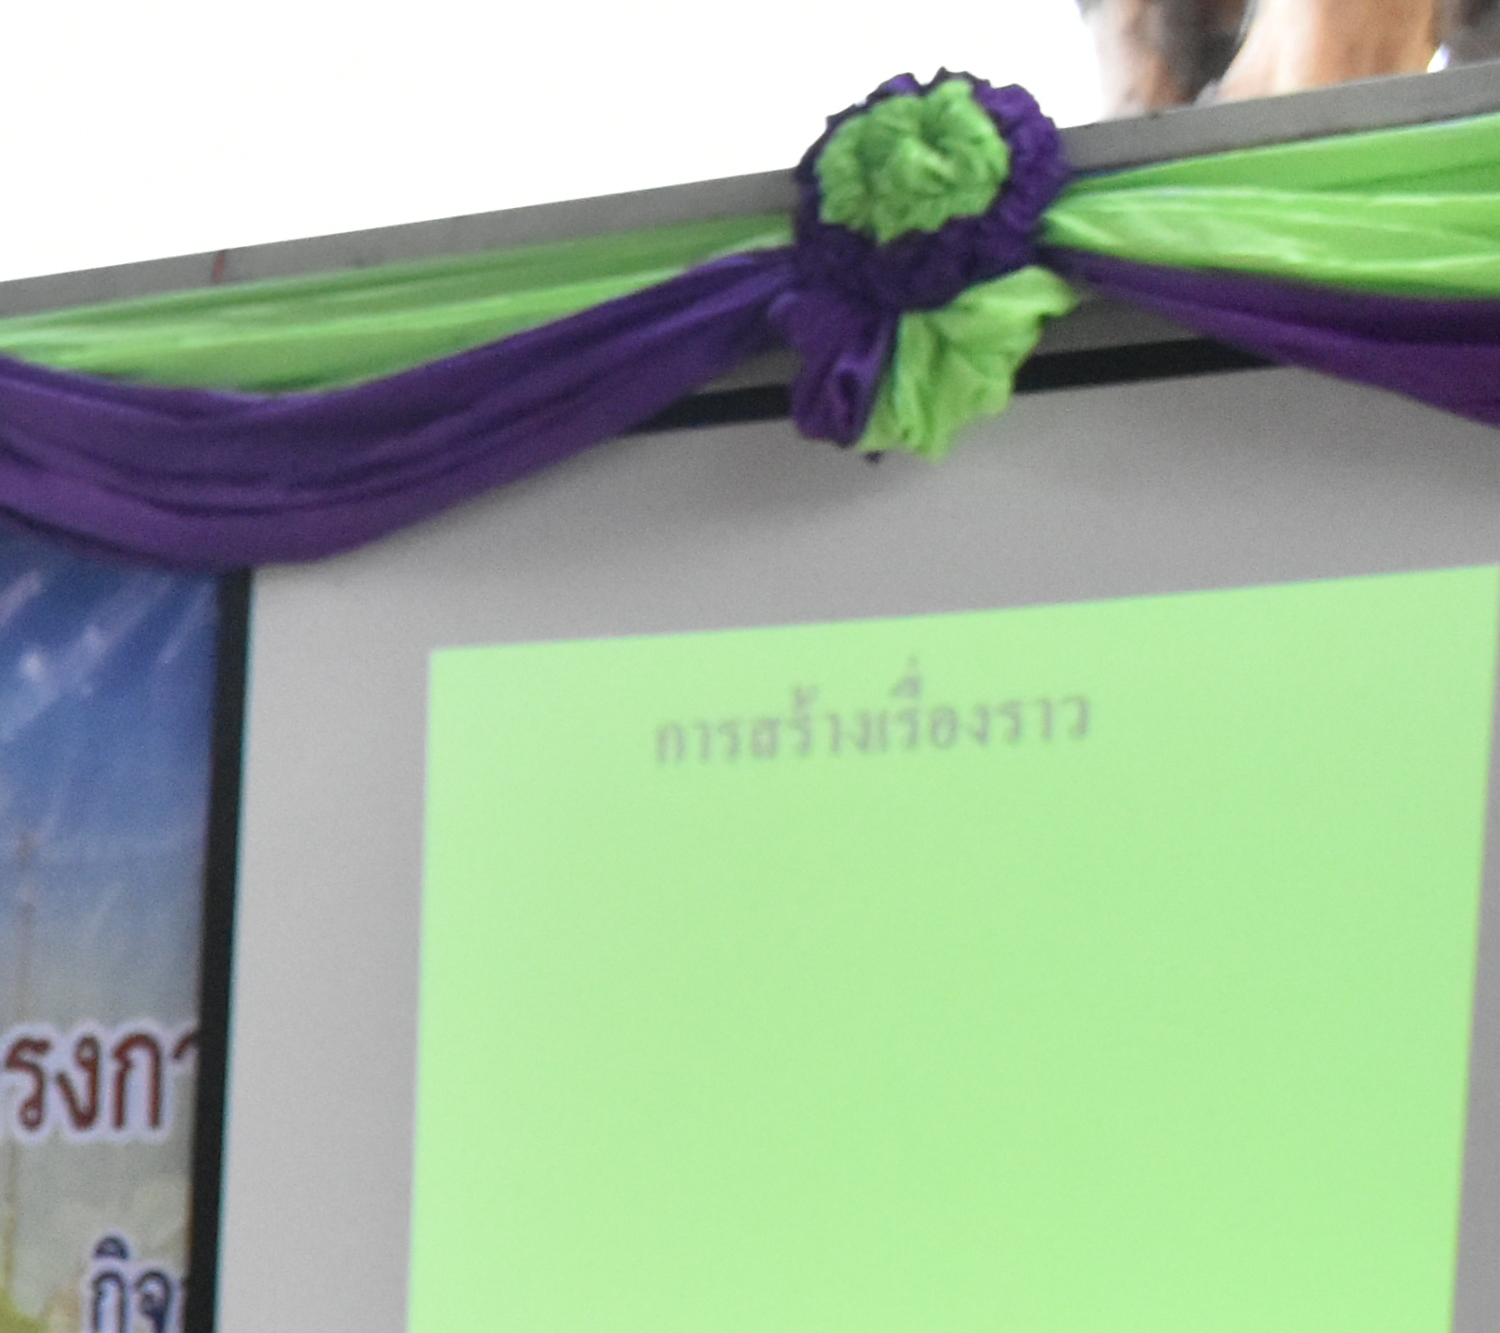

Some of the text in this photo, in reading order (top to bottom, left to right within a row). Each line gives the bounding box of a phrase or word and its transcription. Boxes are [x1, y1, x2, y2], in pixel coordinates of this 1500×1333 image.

[655, 655, 1092, 764] การสร้างเรื่องราว
